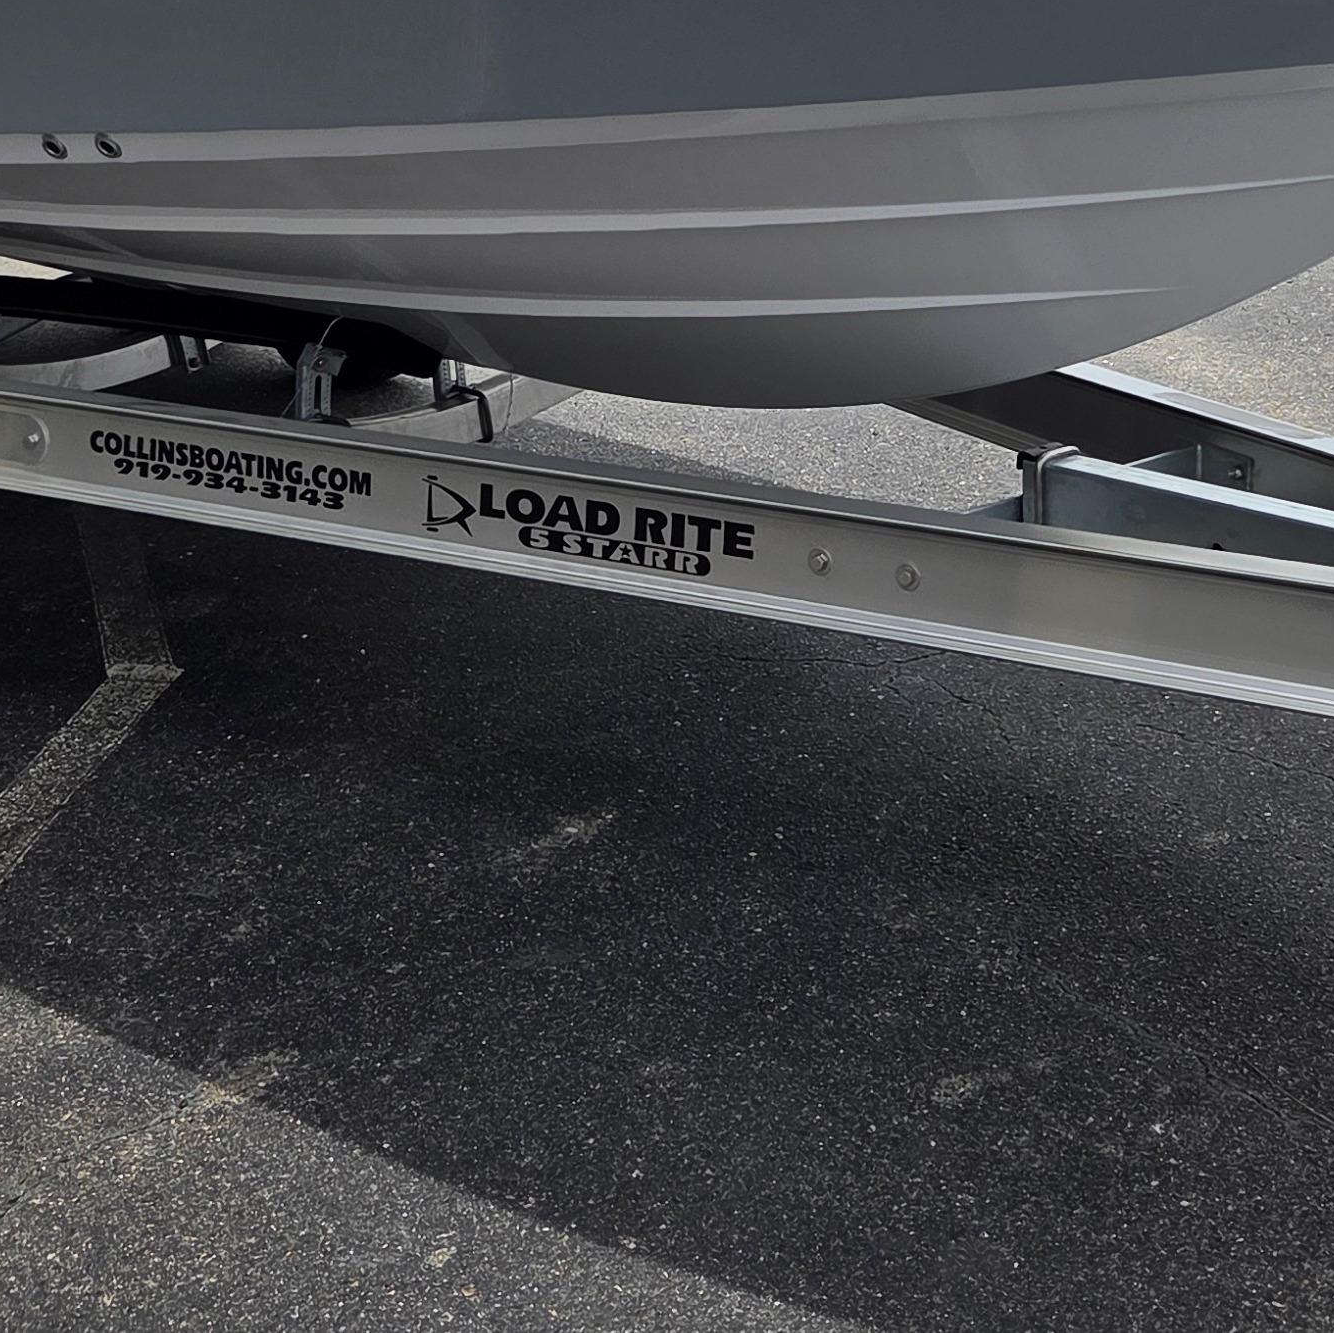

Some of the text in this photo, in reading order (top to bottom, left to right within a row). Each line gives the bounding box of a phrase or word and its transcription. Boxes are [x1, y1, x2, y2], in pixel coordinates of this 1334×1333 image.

[89, 430, 372, 497] COLLINSBOATING.COM
[113, 457, 345, 510] 919-934-3143
[478, 483, 755, 560] LOAD RITE
[529, 528, 699, 575] 5 STARR
